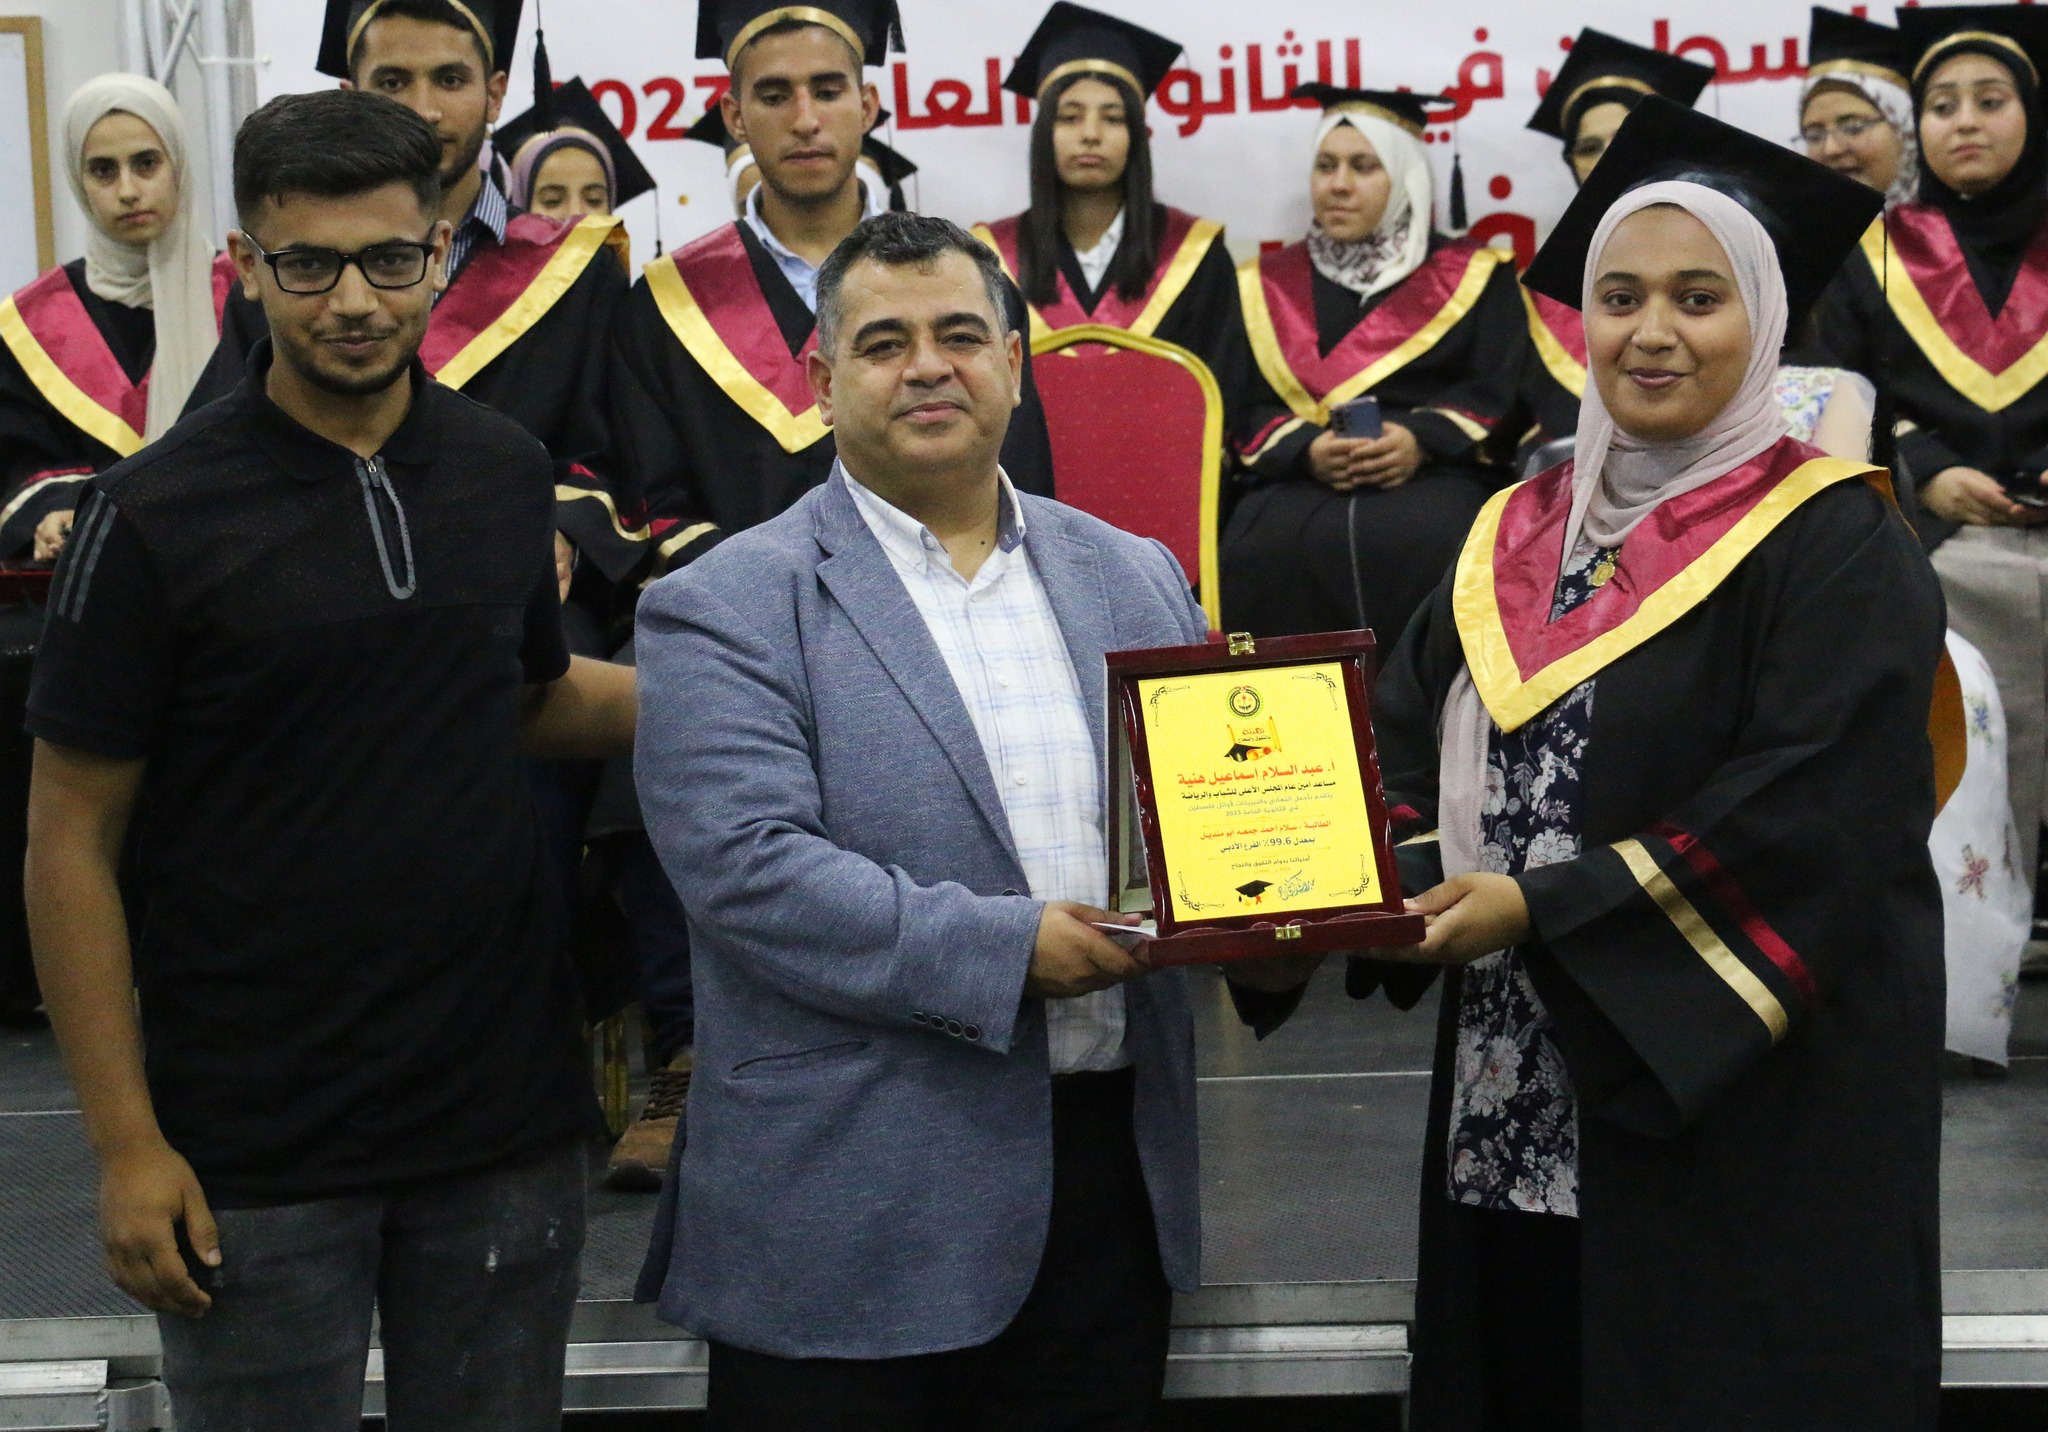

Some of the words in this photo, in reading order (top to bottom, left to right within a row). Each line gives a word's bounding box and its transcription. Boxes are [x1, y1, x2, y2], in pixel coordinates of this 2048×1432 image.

[1262, 764, 1298, 782] السلام
[1301, 762, 1323, 777] عبد
[1177, 773, 1206, 788] هنية
[1313, 780, 1336, 788] مساعد
[1261, 784, 1284, 794] المجلس
[1284, 783, 1296, 792] عام
[1180, 790, 1212, 801] والرياضة
[1212, 788, 1237, 799] للشباب
[1225, 809, 1242, 817] 2023
[1279, 824, 1298, 833] سلام
[1304, 820, 1332, 830] الطالبة
[1293, 837, 1316, 847] بمعدل
